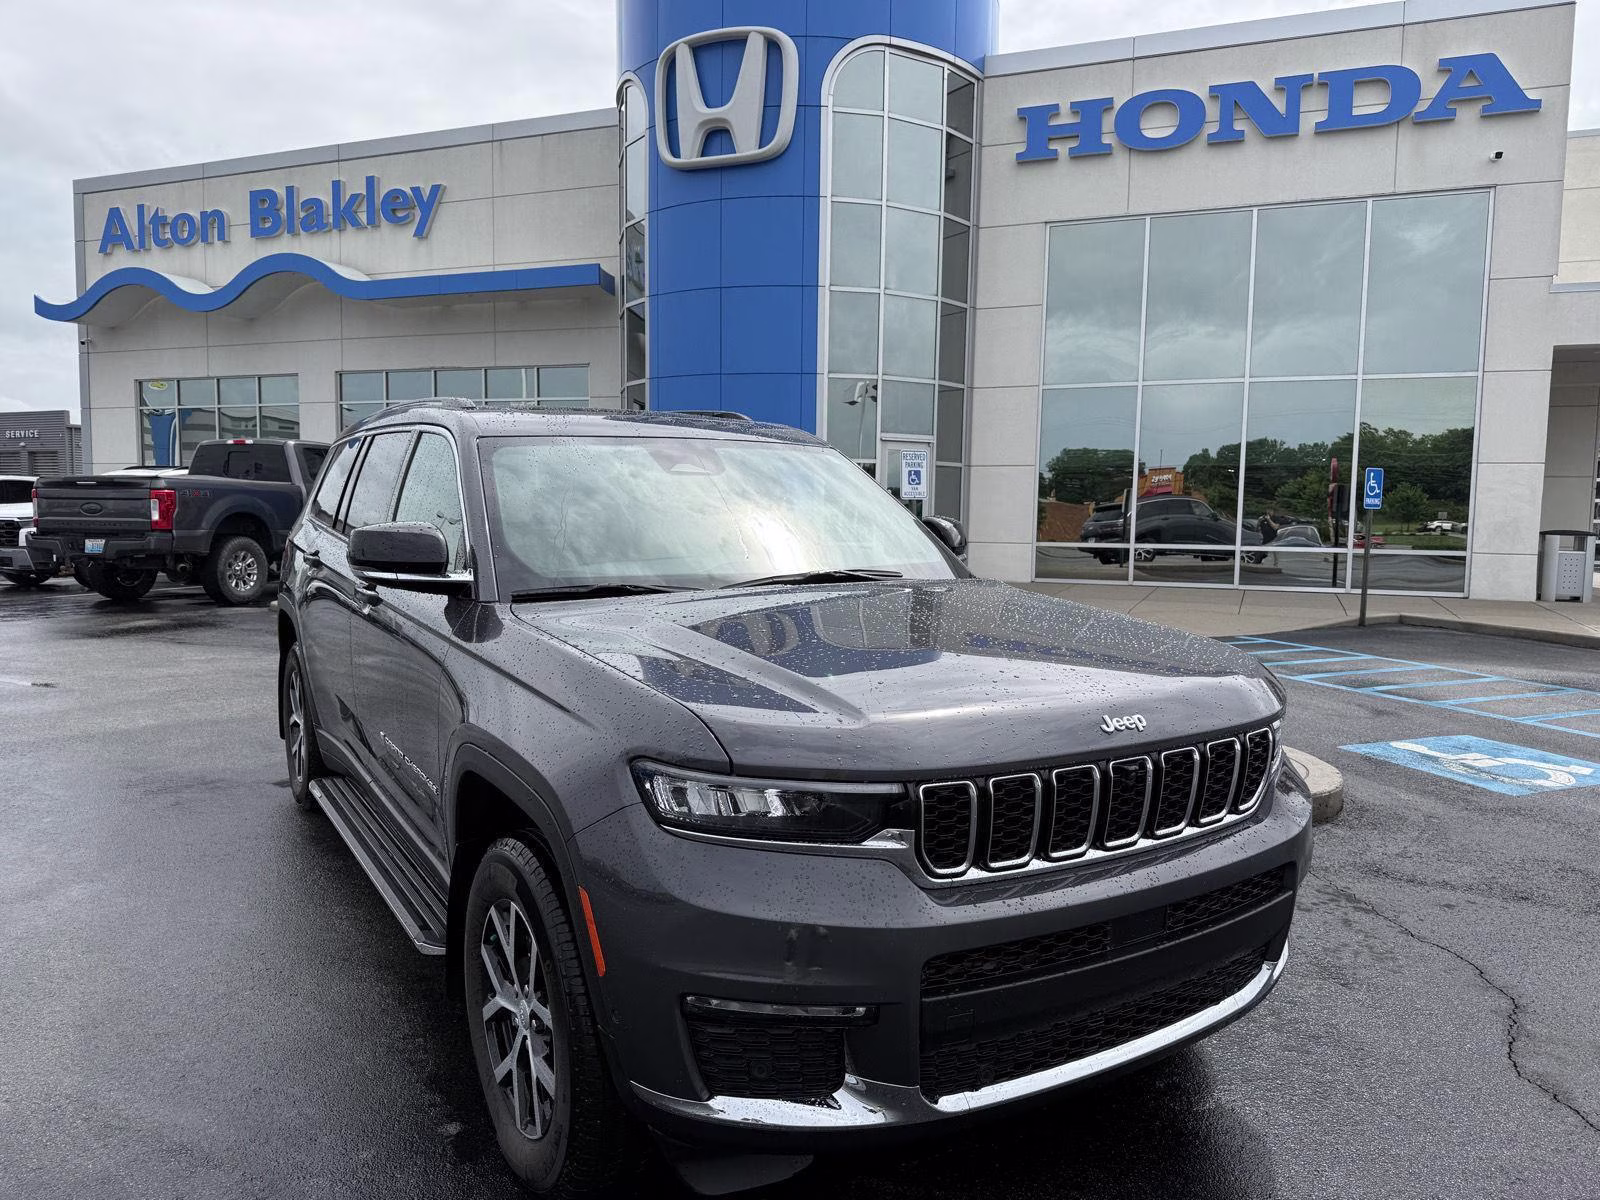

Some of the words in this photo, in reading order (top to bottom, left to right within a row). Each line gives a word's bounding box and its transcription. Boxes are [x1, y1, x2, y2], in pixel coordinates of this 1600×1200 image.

[1016, 52, 1542, 163] HONDA
[98, 203, 230, 256] Alton
[249, 175, 447, 239] Blakley
[5, 430, 39, 438] SERVICE
[902, 453, 926, 461] RESERVED
[1365, 497, 1380, 505] PARKING
[1100, 714, 1147, 734] Jeep
